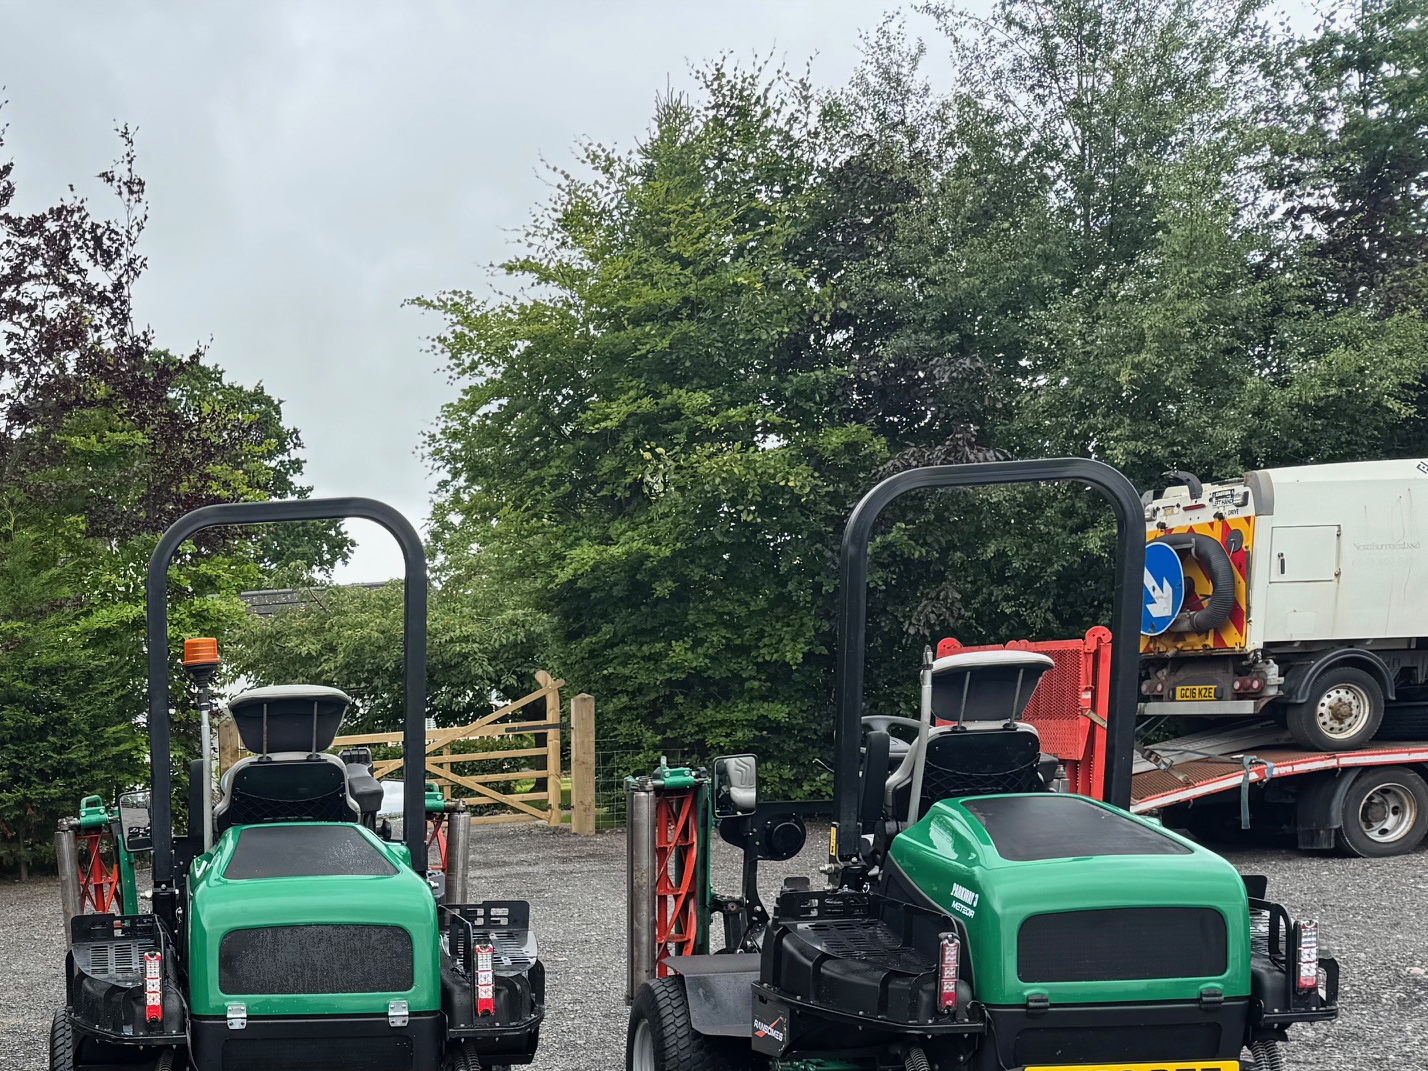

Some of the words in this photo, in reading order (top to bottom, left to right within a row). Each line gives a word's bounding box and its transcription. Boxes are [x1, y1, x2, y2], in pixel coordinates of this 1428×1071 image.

[1180, 687, 1197, 699] GC16
[1198, 687, 1213, 698] KZE
[973, 893, 979, 908] 3
[951, 900, 975, 919] METEOR
[753, 1018, 784, 1042] RANSOMES
